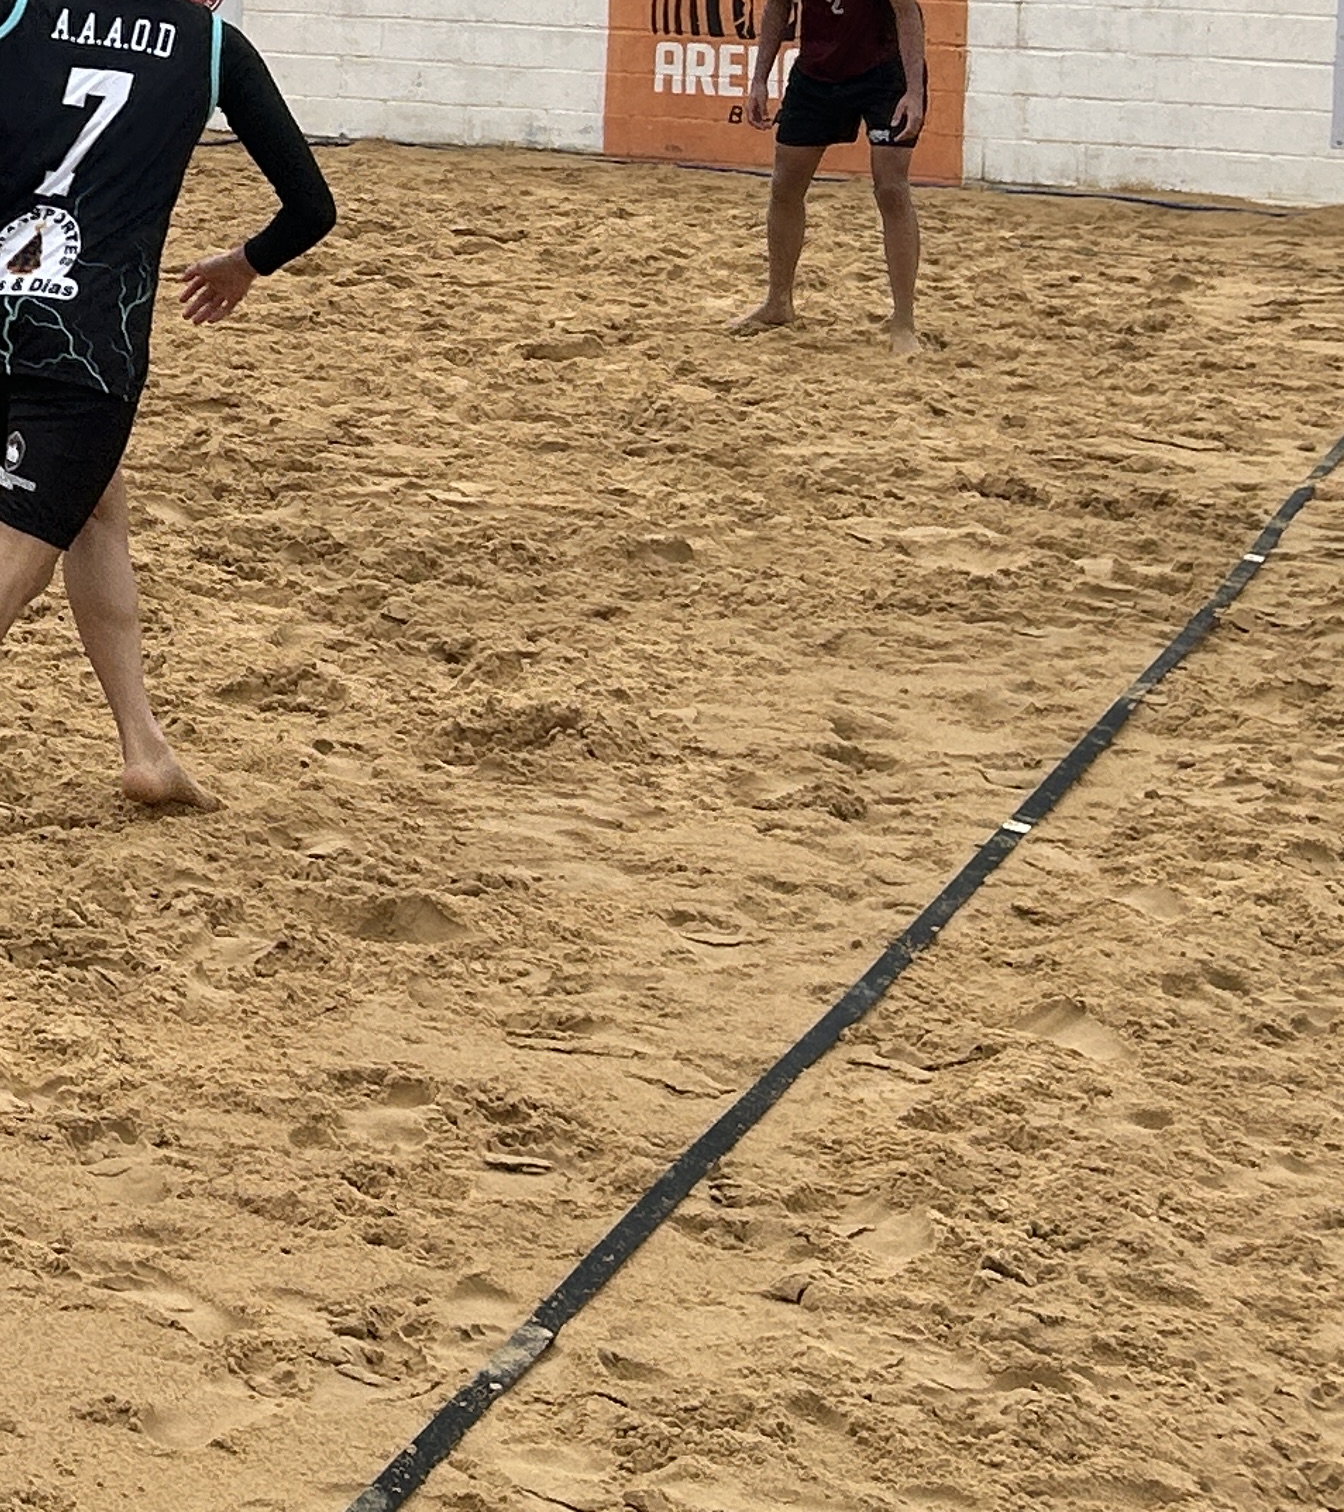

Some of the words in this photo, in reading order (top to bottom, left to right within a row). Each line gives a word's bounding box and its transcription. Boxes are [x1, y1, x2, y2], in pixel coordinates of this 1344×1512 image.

[33, 66, 135, 197] 7
[10, 277, 24, 292] &
[28, 277, 75, 297] Dias
